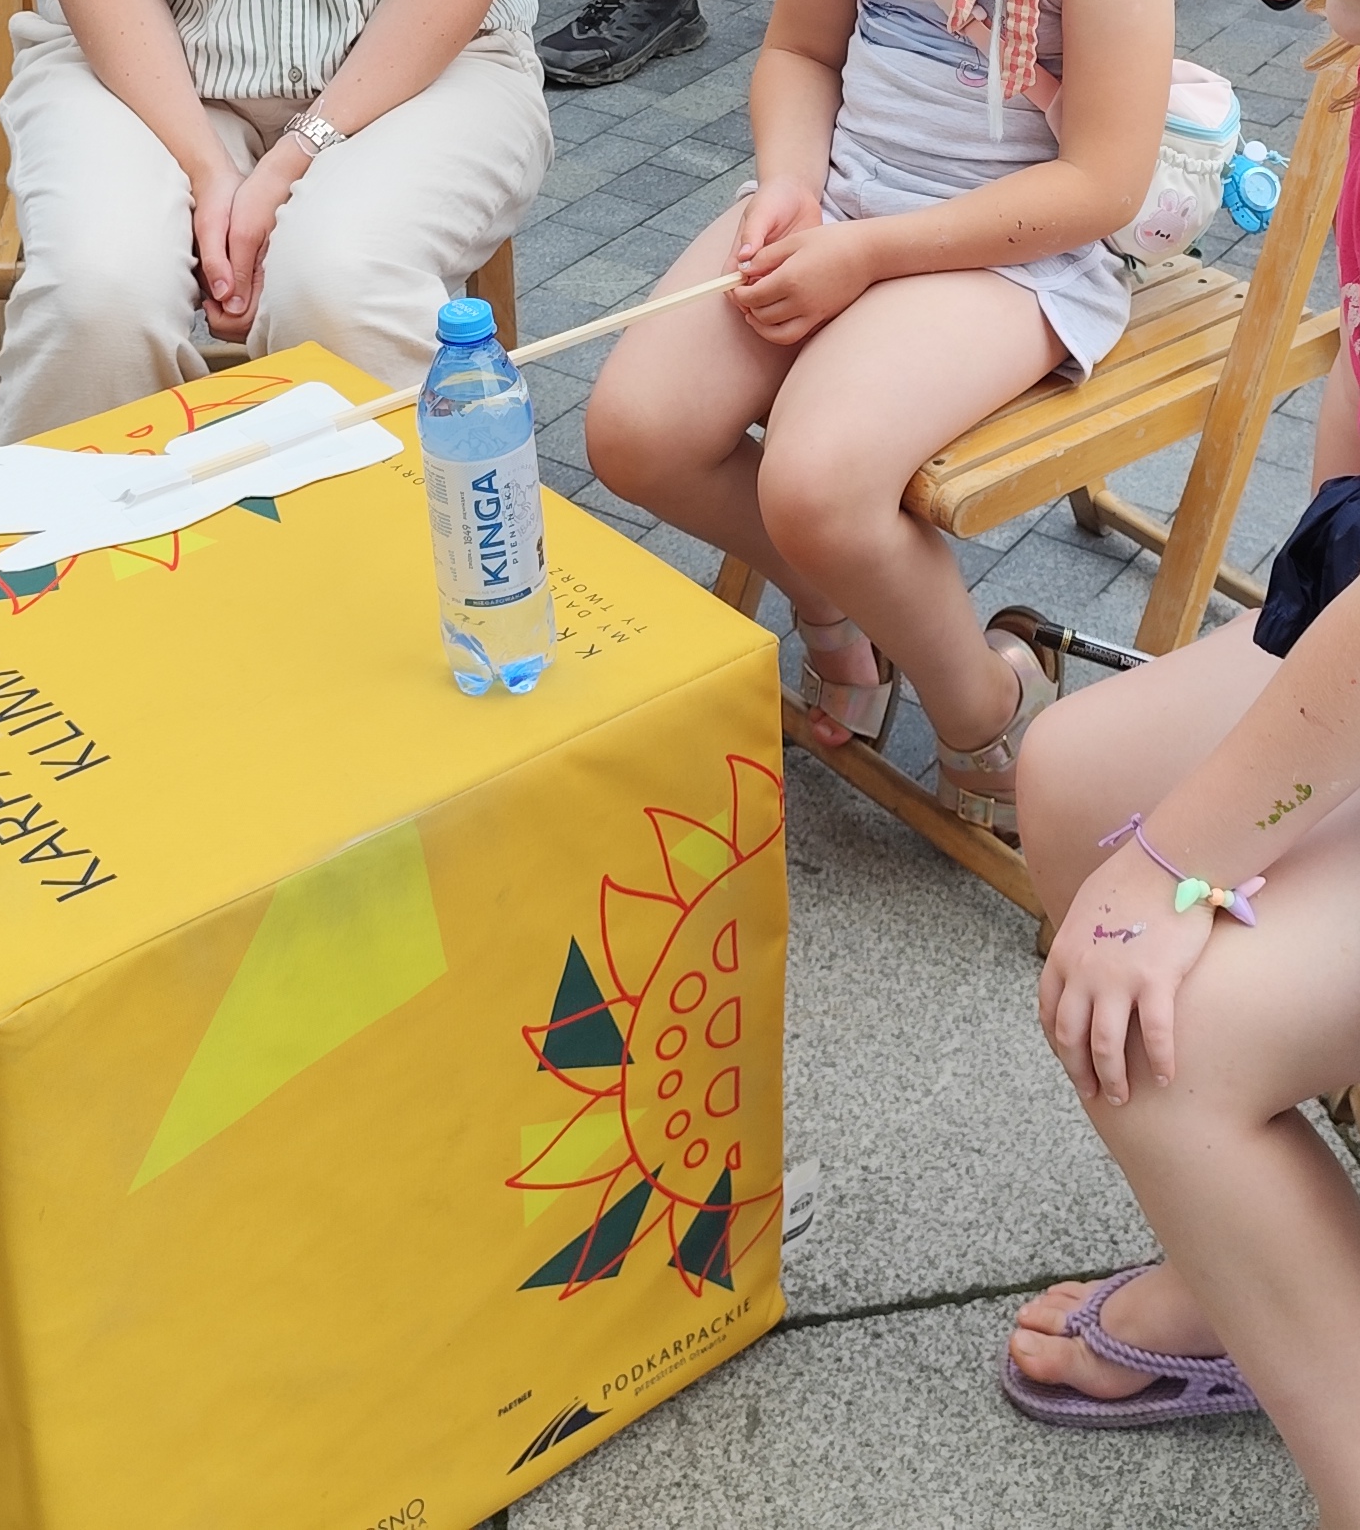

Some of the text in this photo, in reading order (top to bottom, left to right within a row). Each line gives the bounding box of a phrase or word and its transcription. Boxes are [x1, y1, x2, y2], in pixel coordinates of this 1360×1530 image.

[471, 468, 510, 588] KINGA
[601, 1296, 752, 1401] PODKARPACKIE
[497, 1389, 533, 1418] PARTNER
